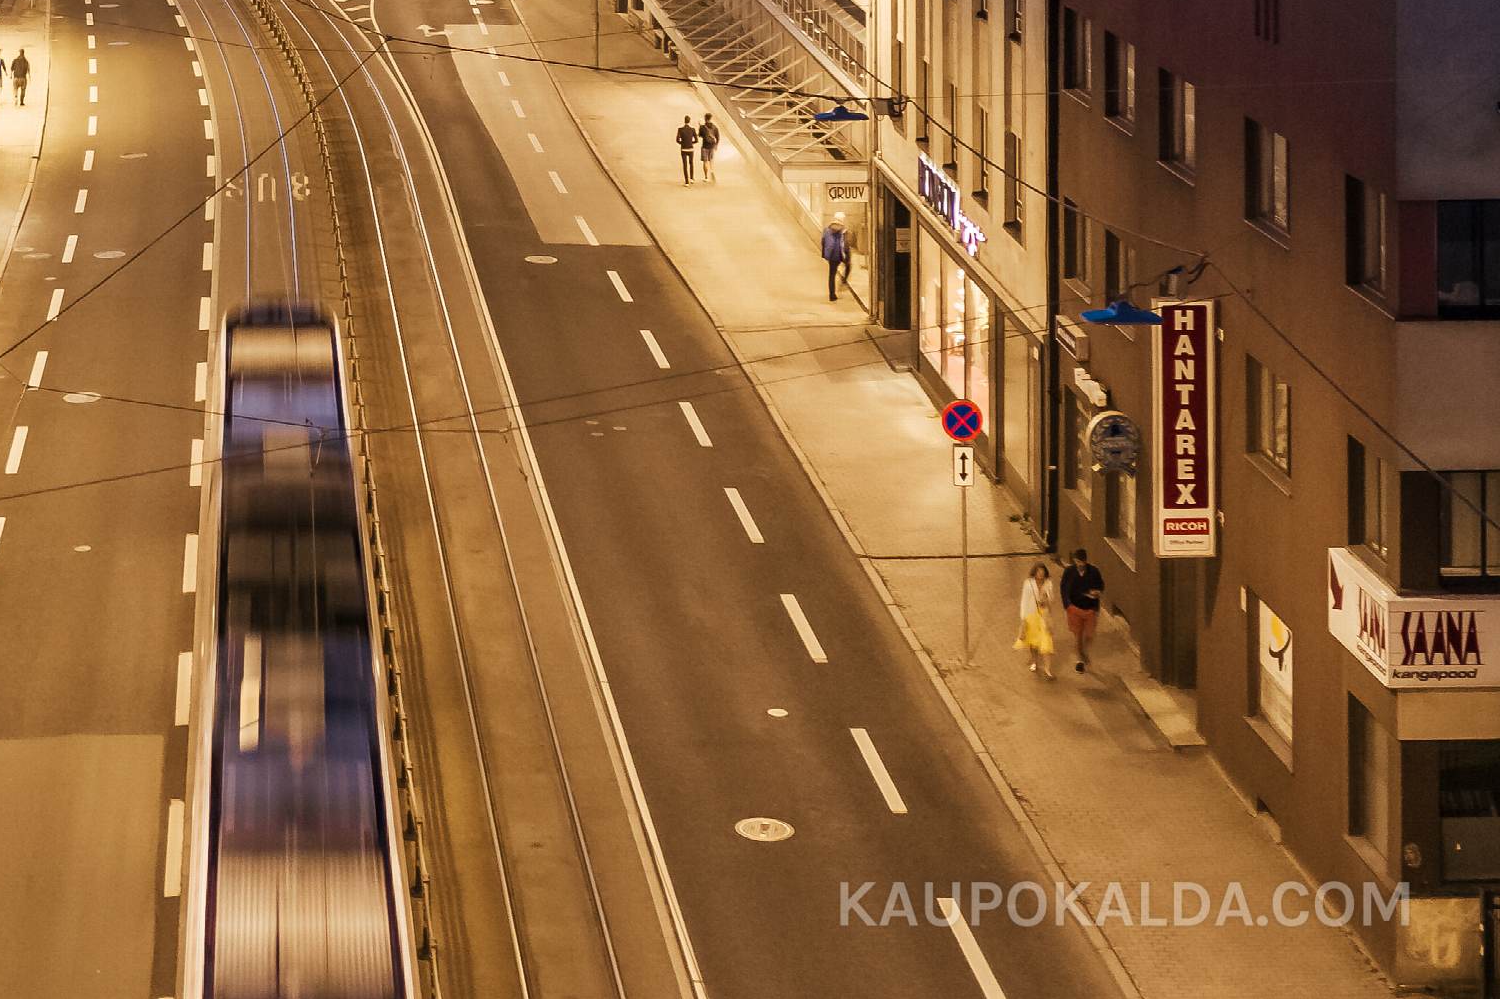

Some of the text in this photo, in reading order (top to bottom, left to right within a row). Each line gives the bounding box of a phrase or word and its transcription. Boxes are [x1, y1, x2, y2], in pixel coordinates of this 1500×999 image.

[828, 186, 865, 200] GRUUV
[1173, 309, 1197, 506] HANTAREX
[1166, 521, 1207, 531] RICOH
[1401, 611, 1481, 666] SAANA
[1392, 668, 1478, 681] kangapood
